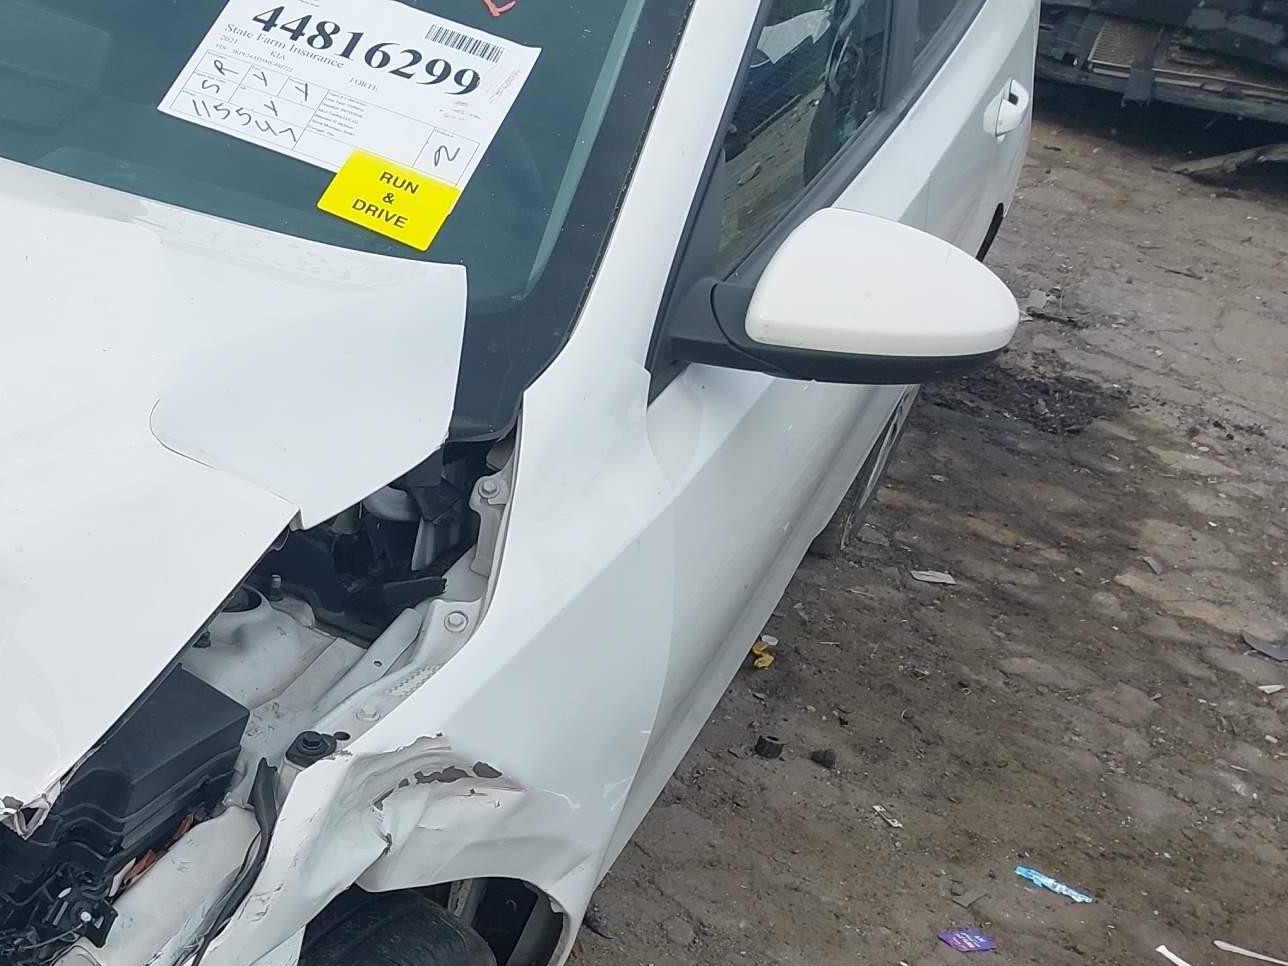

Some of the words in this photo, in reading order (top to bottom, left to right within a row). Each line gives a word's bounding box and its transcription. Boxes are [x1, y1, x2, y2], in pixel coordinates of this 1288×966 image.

[219, 34, 239, 45] 2021
[270, 50, 286, 61] KIA
[224, 23, 254, 39] State
[257, 31, 286, 50] Farm
[290, 43, 345, 69] Insurance
[252, 5, 481, 95] 44816299
[379, 171, 420, 194] RUN
[382, 192, 394, 205] &
[352, 198, 409, 229] DRIVE
